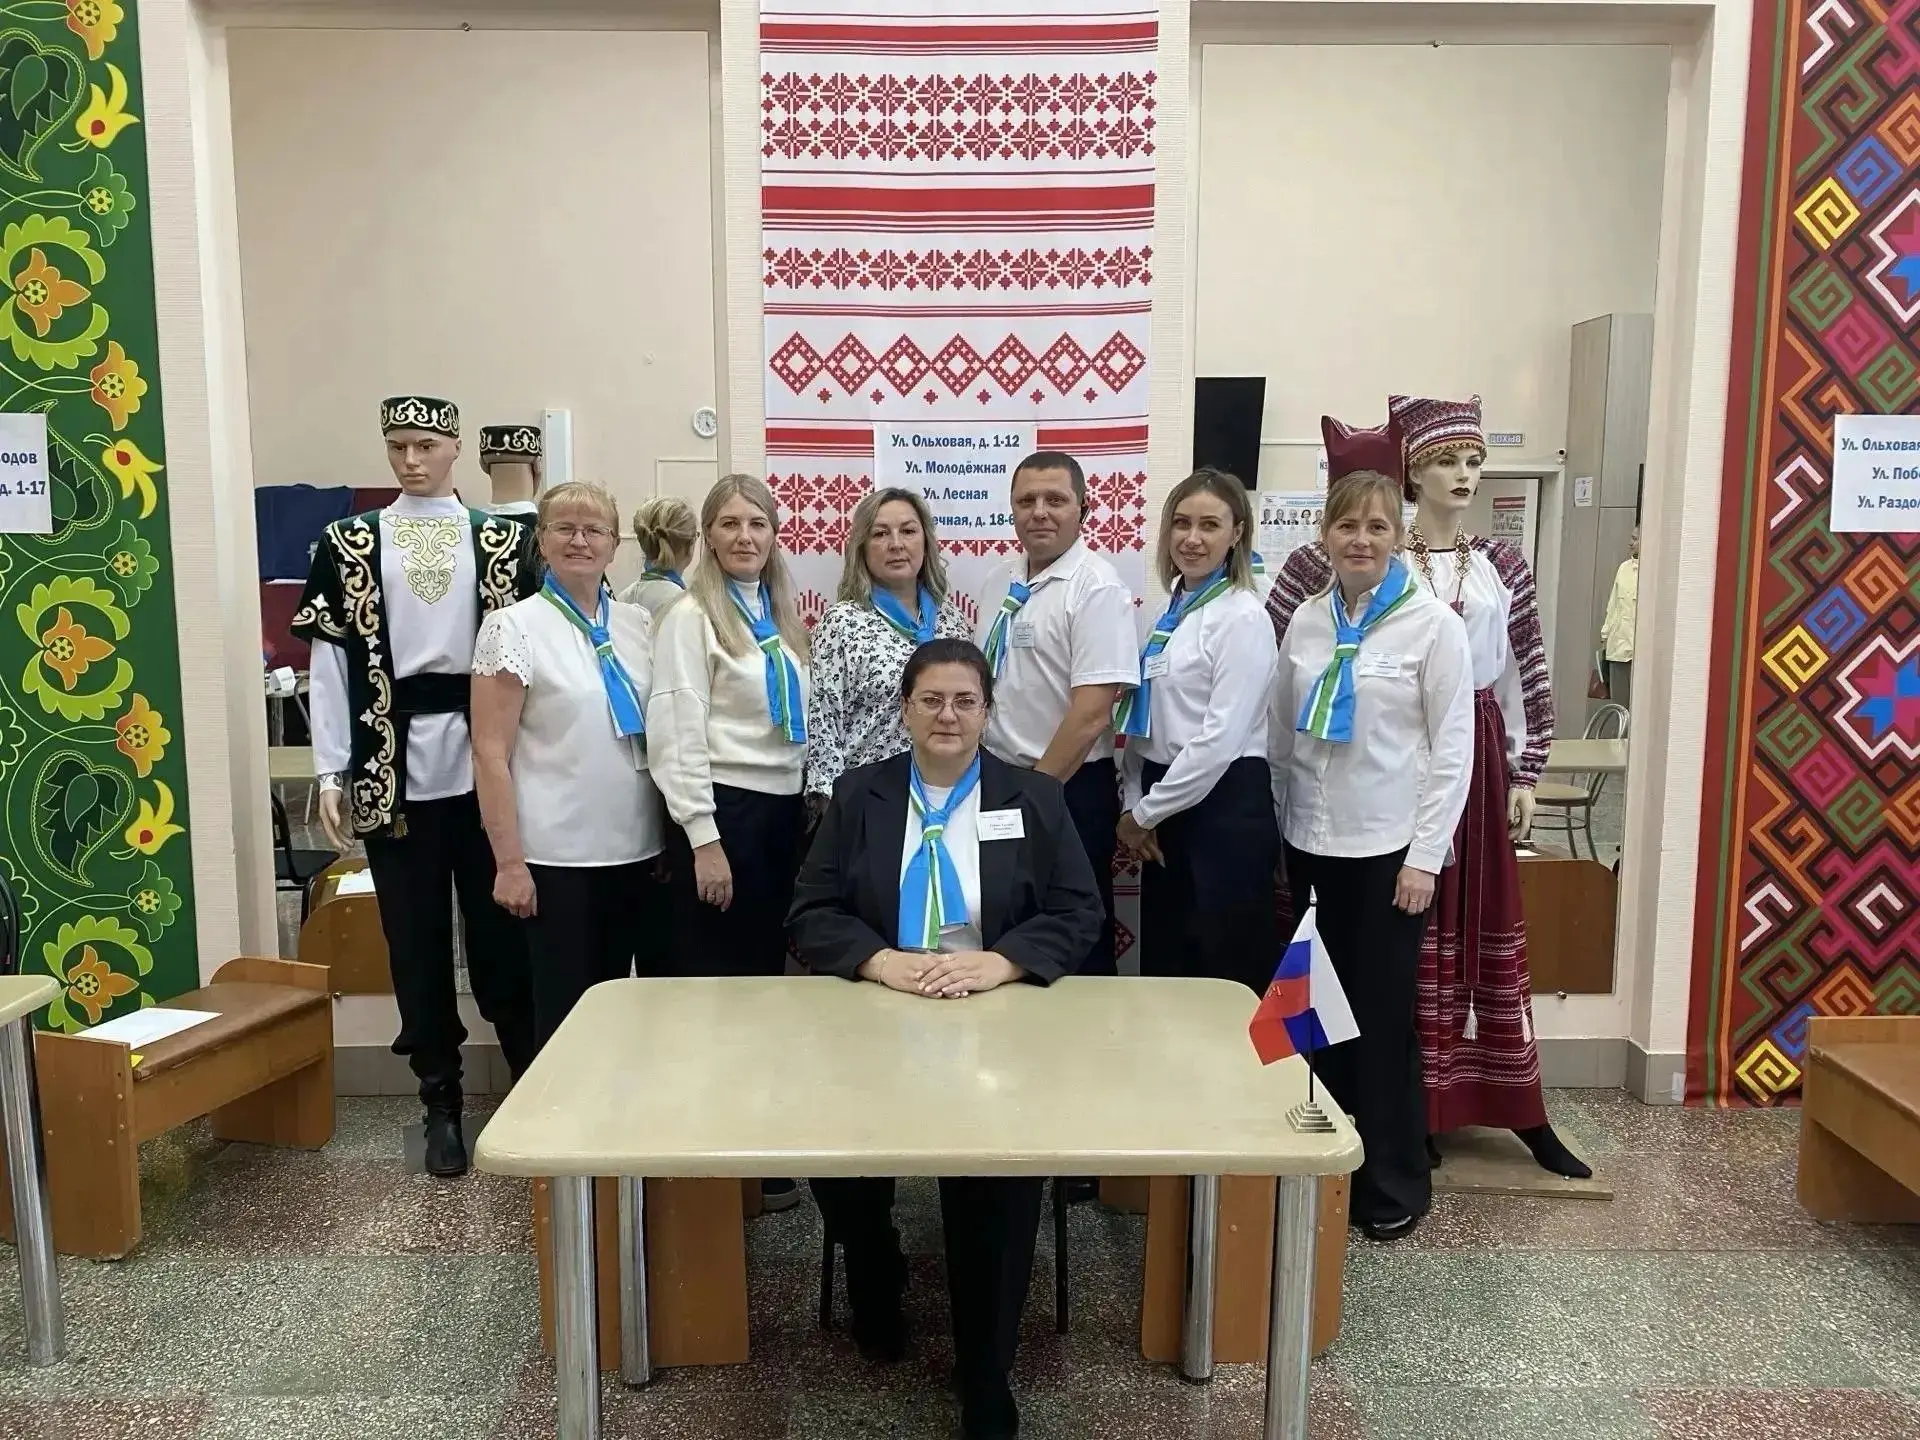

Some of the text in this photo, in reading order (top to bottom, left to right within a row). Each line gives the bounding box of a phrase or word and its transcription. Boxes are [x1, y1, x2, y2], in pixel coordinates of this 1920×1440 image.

[892, 434, 1020, 450] Ул. Ольховая, д. 1-12
[1842, 438, 1858, 450] Ул.
[0, 452, 38, 466] одов
[905, 461, 1006, 475] Ул. Молодёжная
[1872, 466, 1920, 479] Ул. Поб
[17, 480, 46, 495] 1-17
[923, 487, 988, 500] Ул. Лесная
[1858, 496, 1874, 508] Ул.
[933, 512, 1016, 528] ечная, д. 18-6
